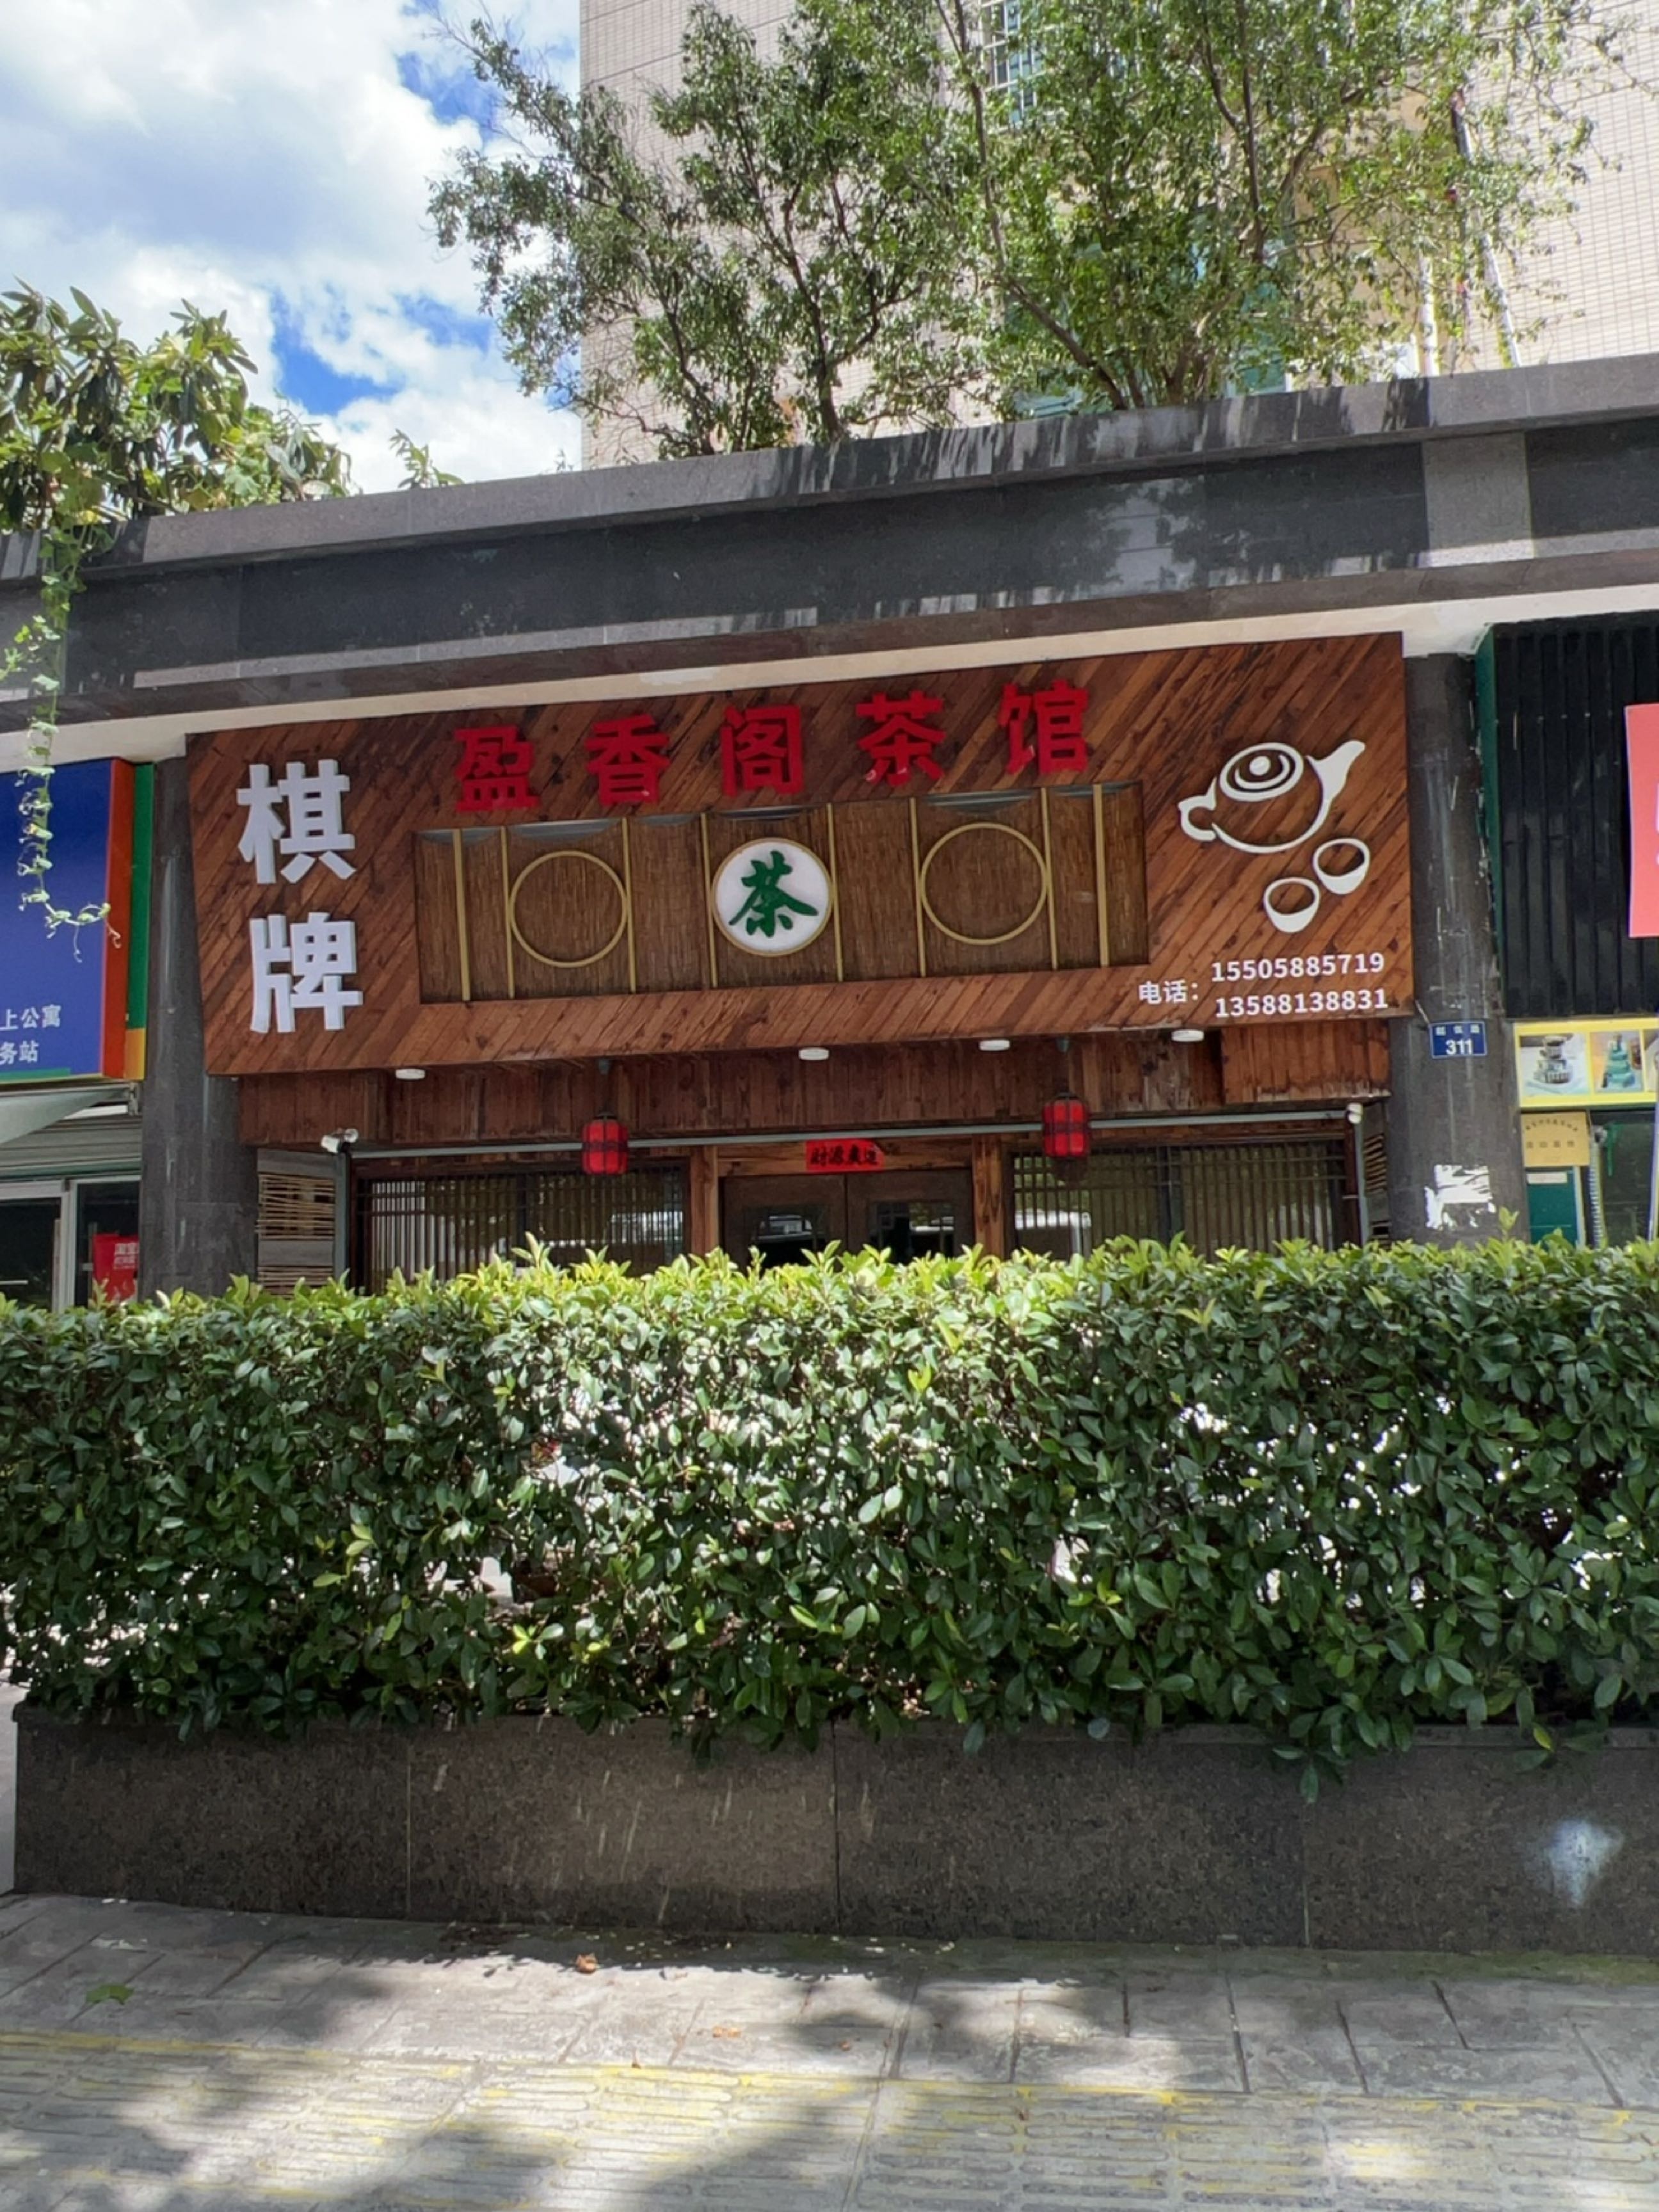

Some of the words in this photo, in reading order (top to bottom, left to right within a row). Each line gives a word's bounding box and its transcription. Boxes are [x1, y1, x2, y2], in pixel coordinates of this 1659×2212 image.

[454, 679, 1090, 812] 盈香阁茶馆
[237, 759, 362, 1033] 棋牌
[728, 850, 817, 938] 茶
[1212, 952, 1384, 982] 15505885719
[0, 1004, 62, 1031] 上公寓
[1216, 988, 1388, 1018] 13588138831
[1445, 1038, 1474, 1055] 311
